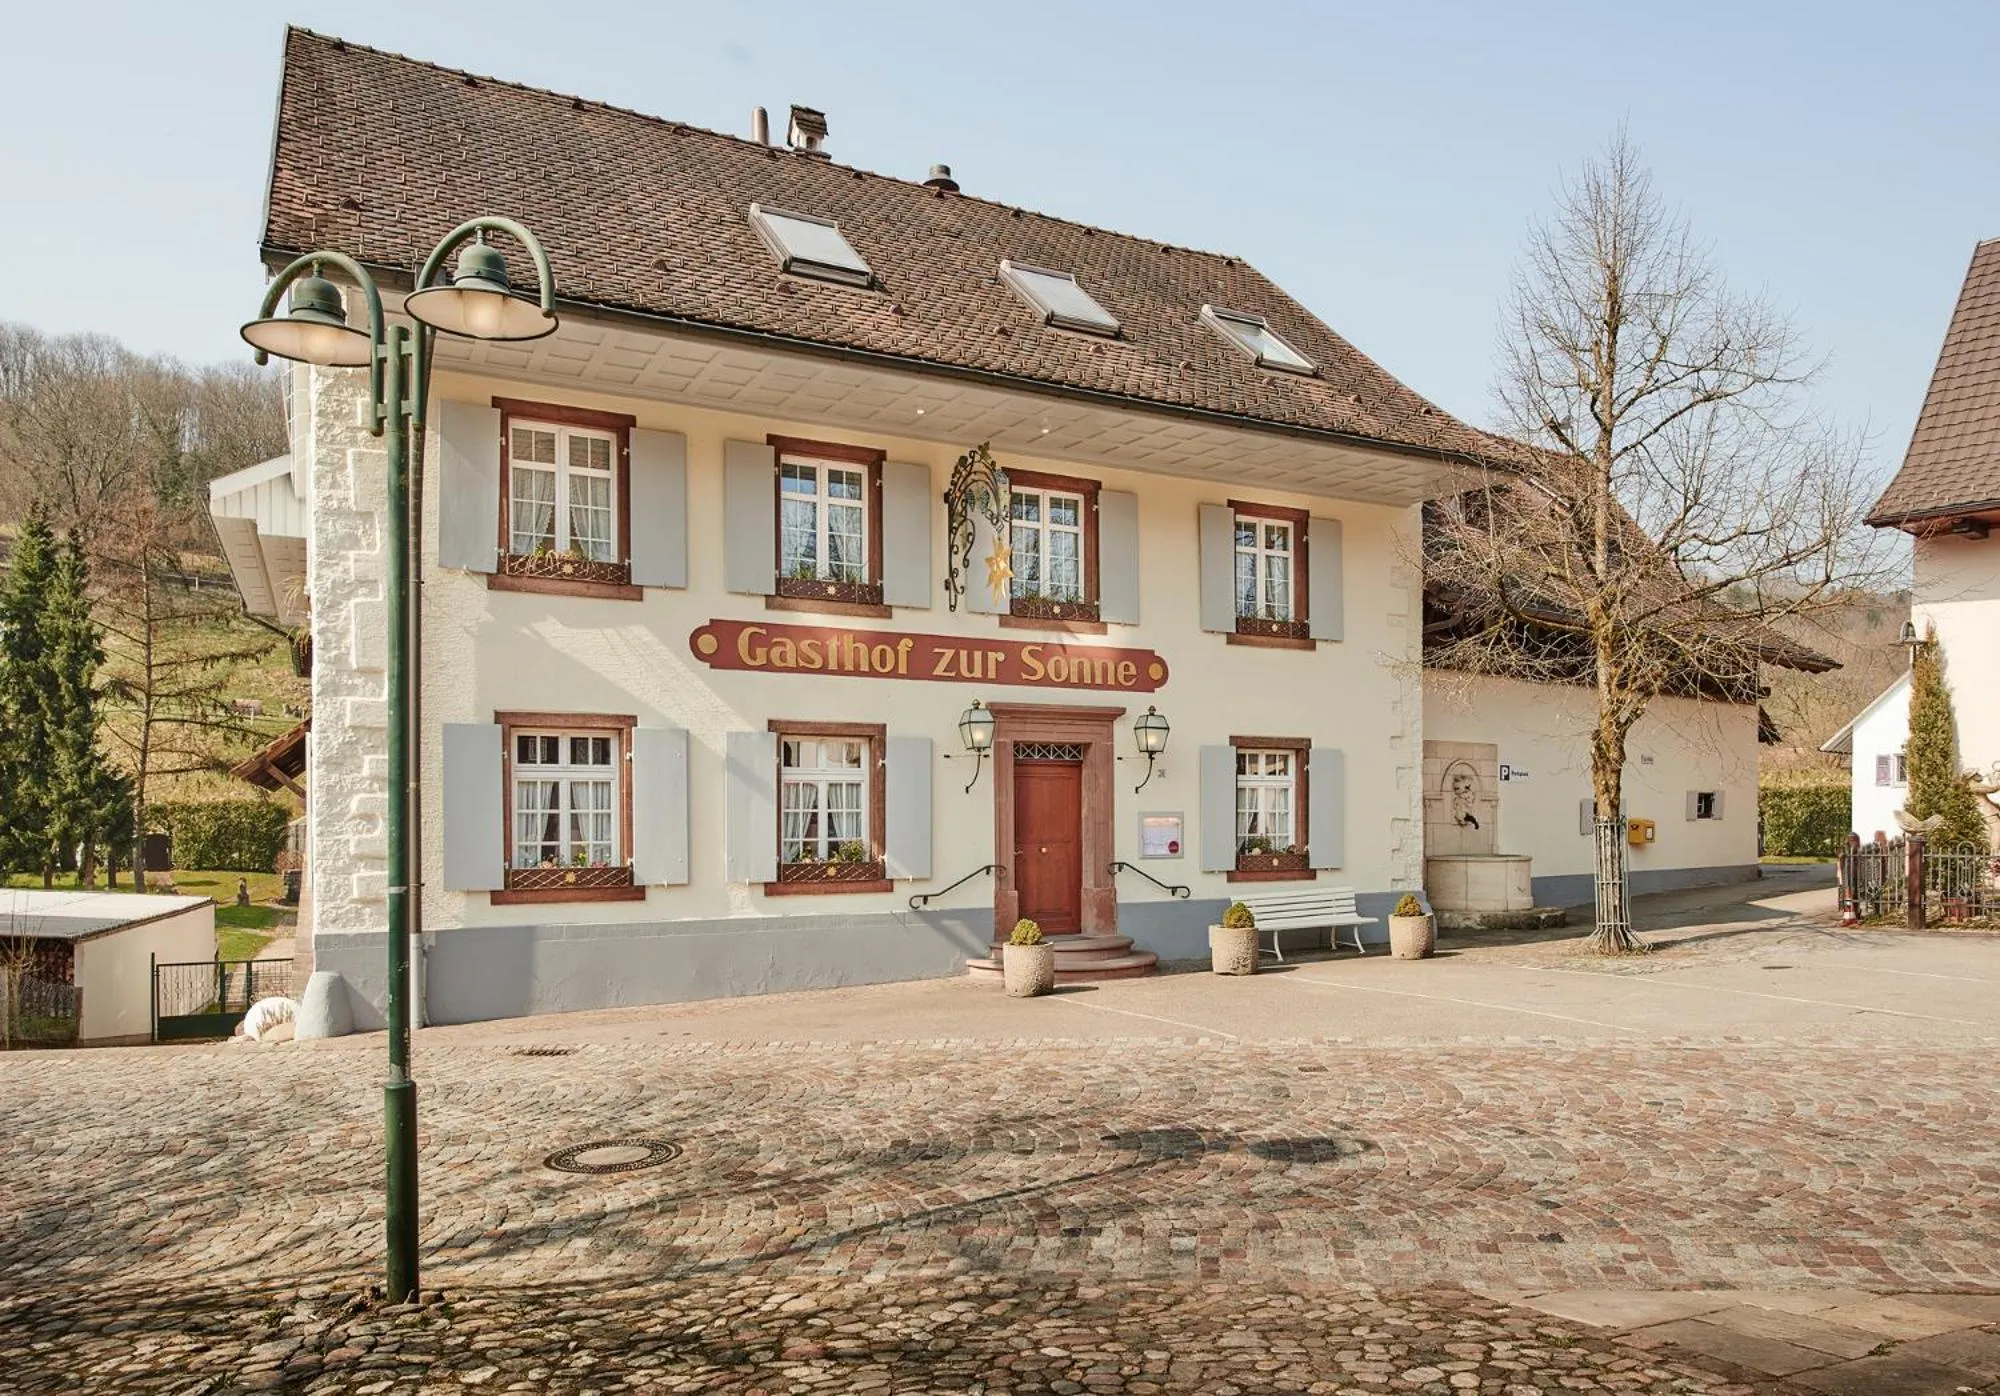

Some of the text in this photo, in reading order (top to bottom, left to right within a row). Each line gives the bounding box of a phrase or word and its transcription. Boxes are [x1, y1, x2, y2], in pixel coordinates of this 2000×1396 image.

[737, 626, 1138, 686] Gasthof zur Sonne
